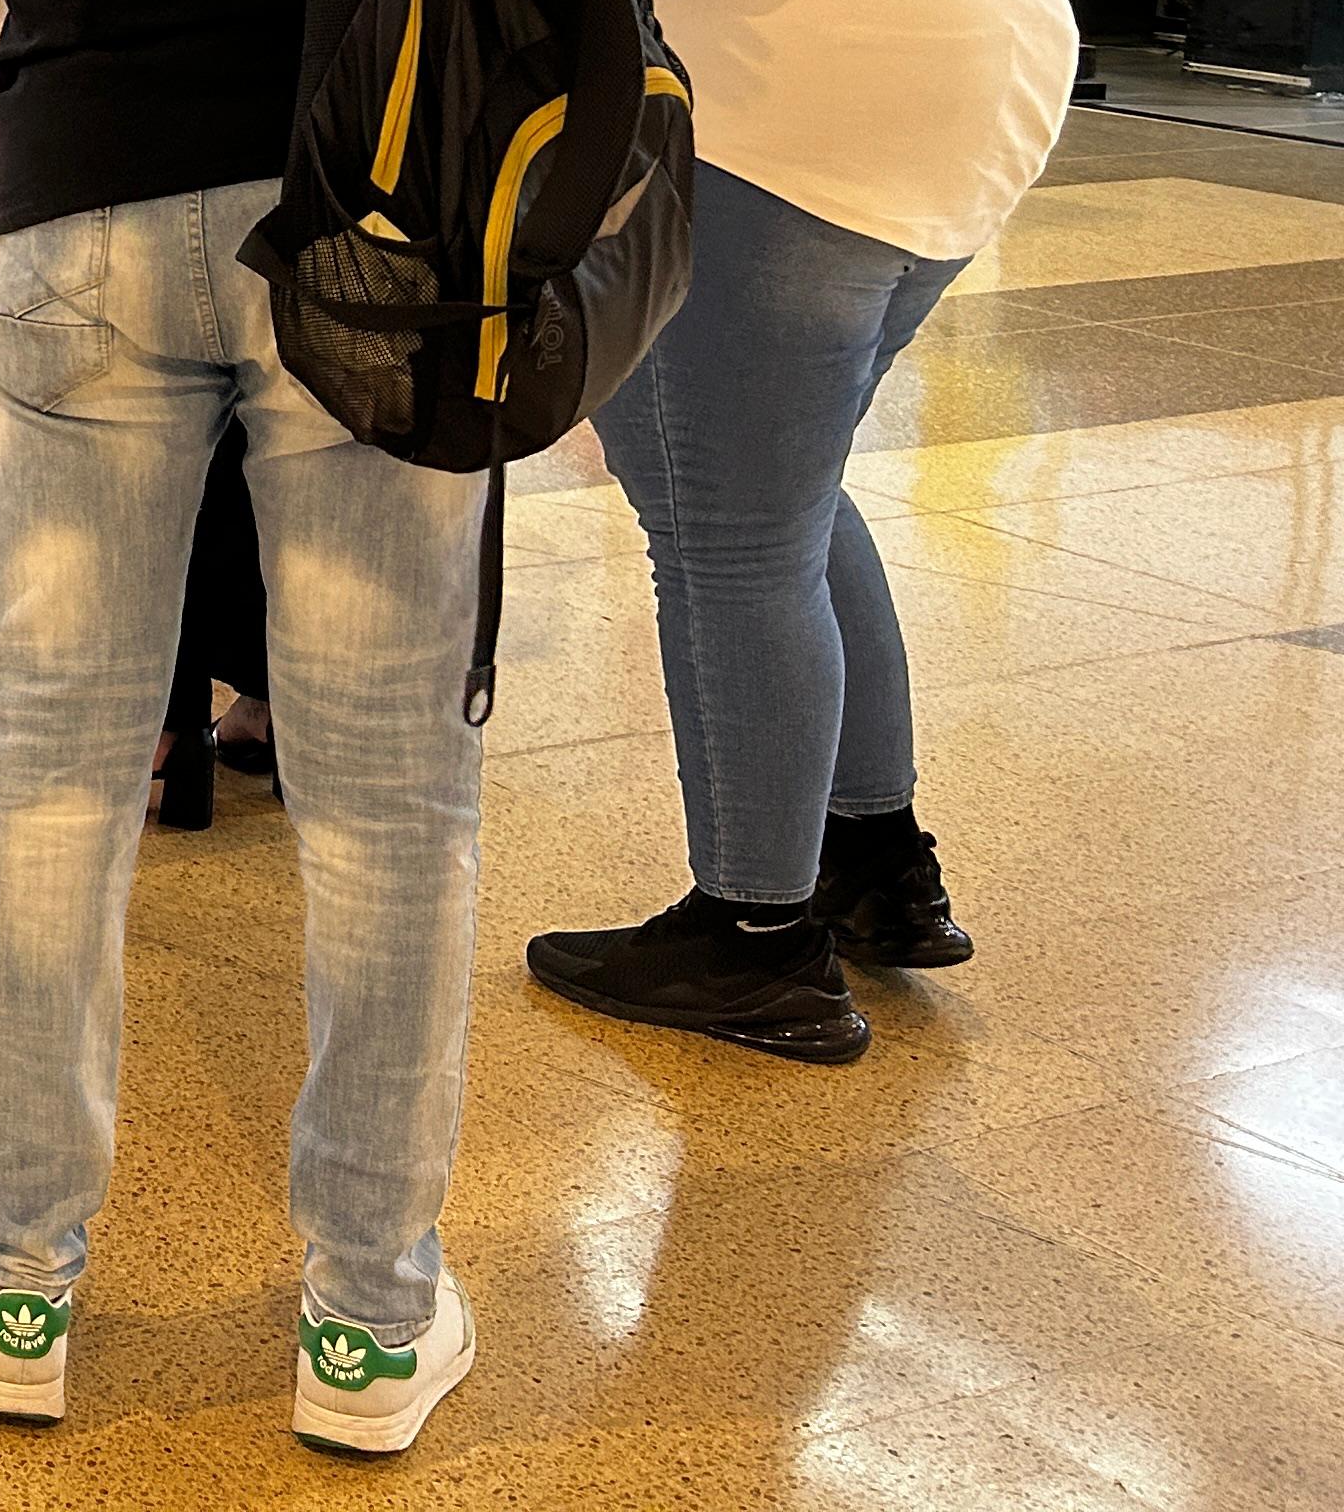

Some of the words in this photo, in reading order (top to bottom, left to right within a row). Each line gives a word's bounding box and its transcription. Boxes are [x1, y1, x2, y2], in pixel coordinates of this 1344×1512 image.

[0, 1328, 20, 1348] rod
[21, 1332, 46, 1350] laver
[317, 1354, 333, 1376] rod
[334, 1367, 365, 1381] laver
